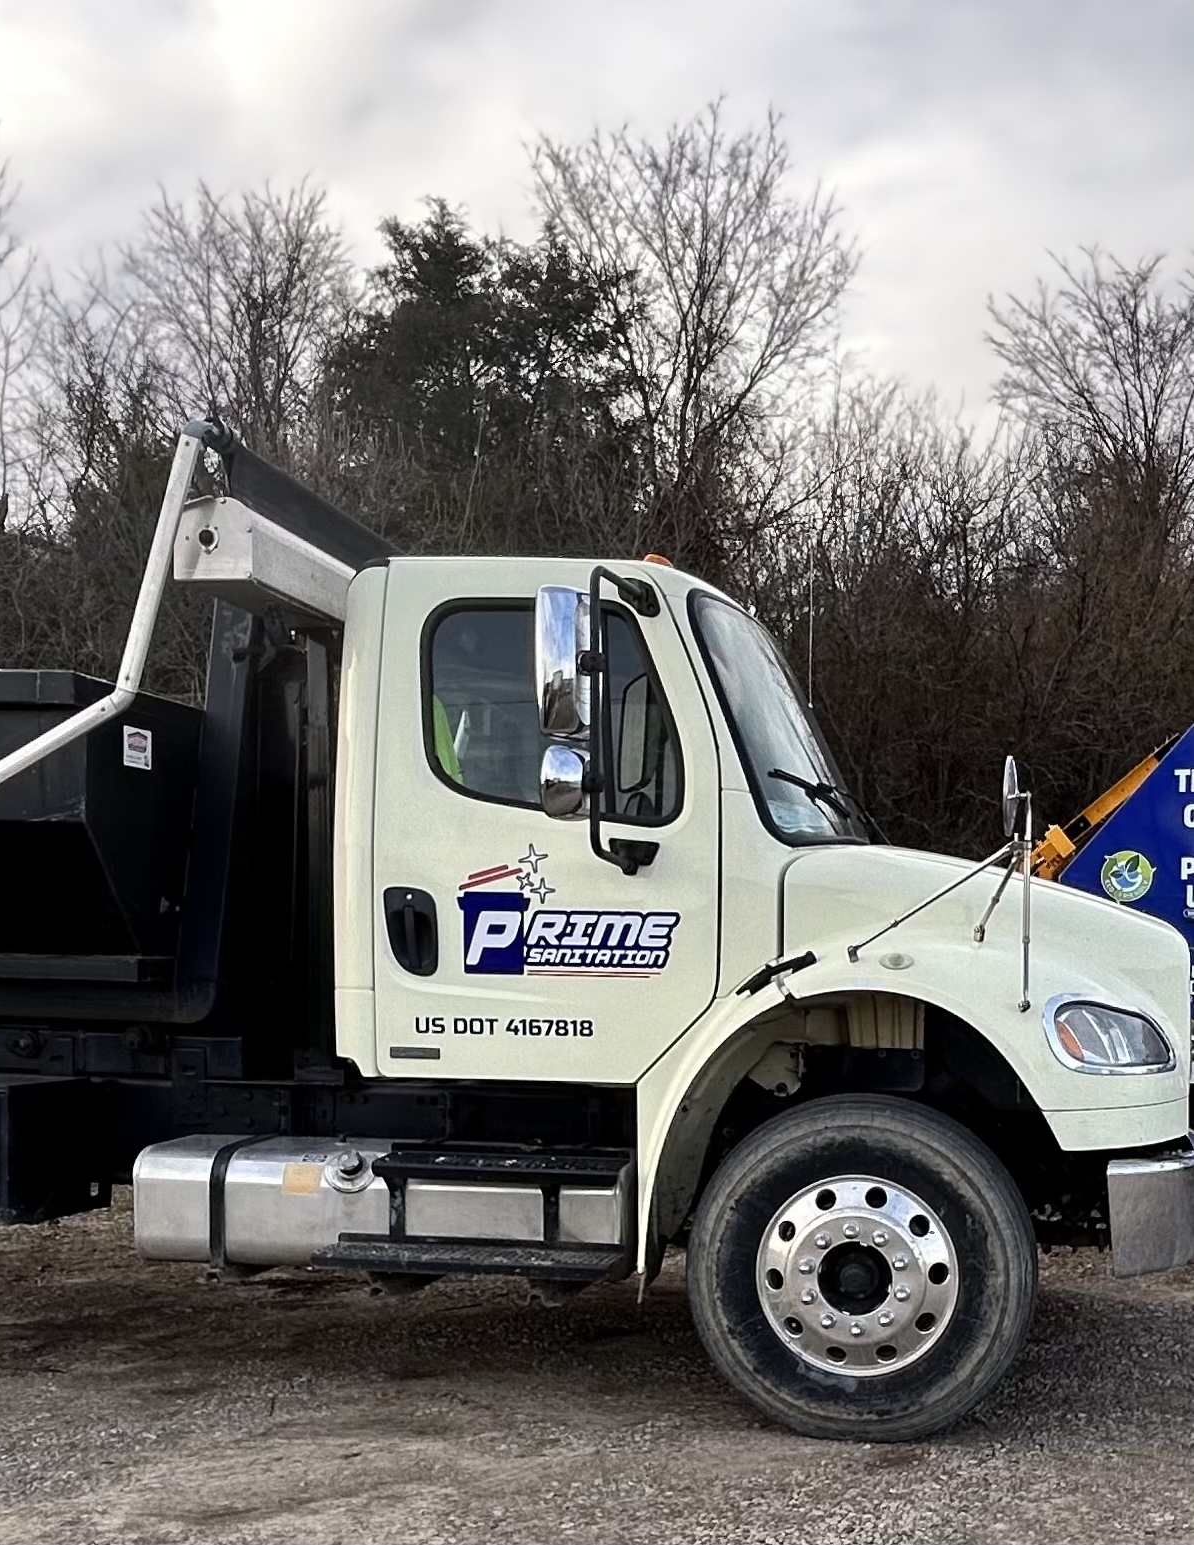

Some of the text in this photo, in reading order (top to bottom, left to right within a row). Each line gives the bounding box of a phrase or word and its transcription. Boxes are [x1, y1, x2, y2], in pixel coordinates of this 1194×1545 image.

[465, 910, 677, 966] PRIME
[526, 948, 667, 966] SANITATION
[415, 1016, 594, 1037] US DOT 4167818
